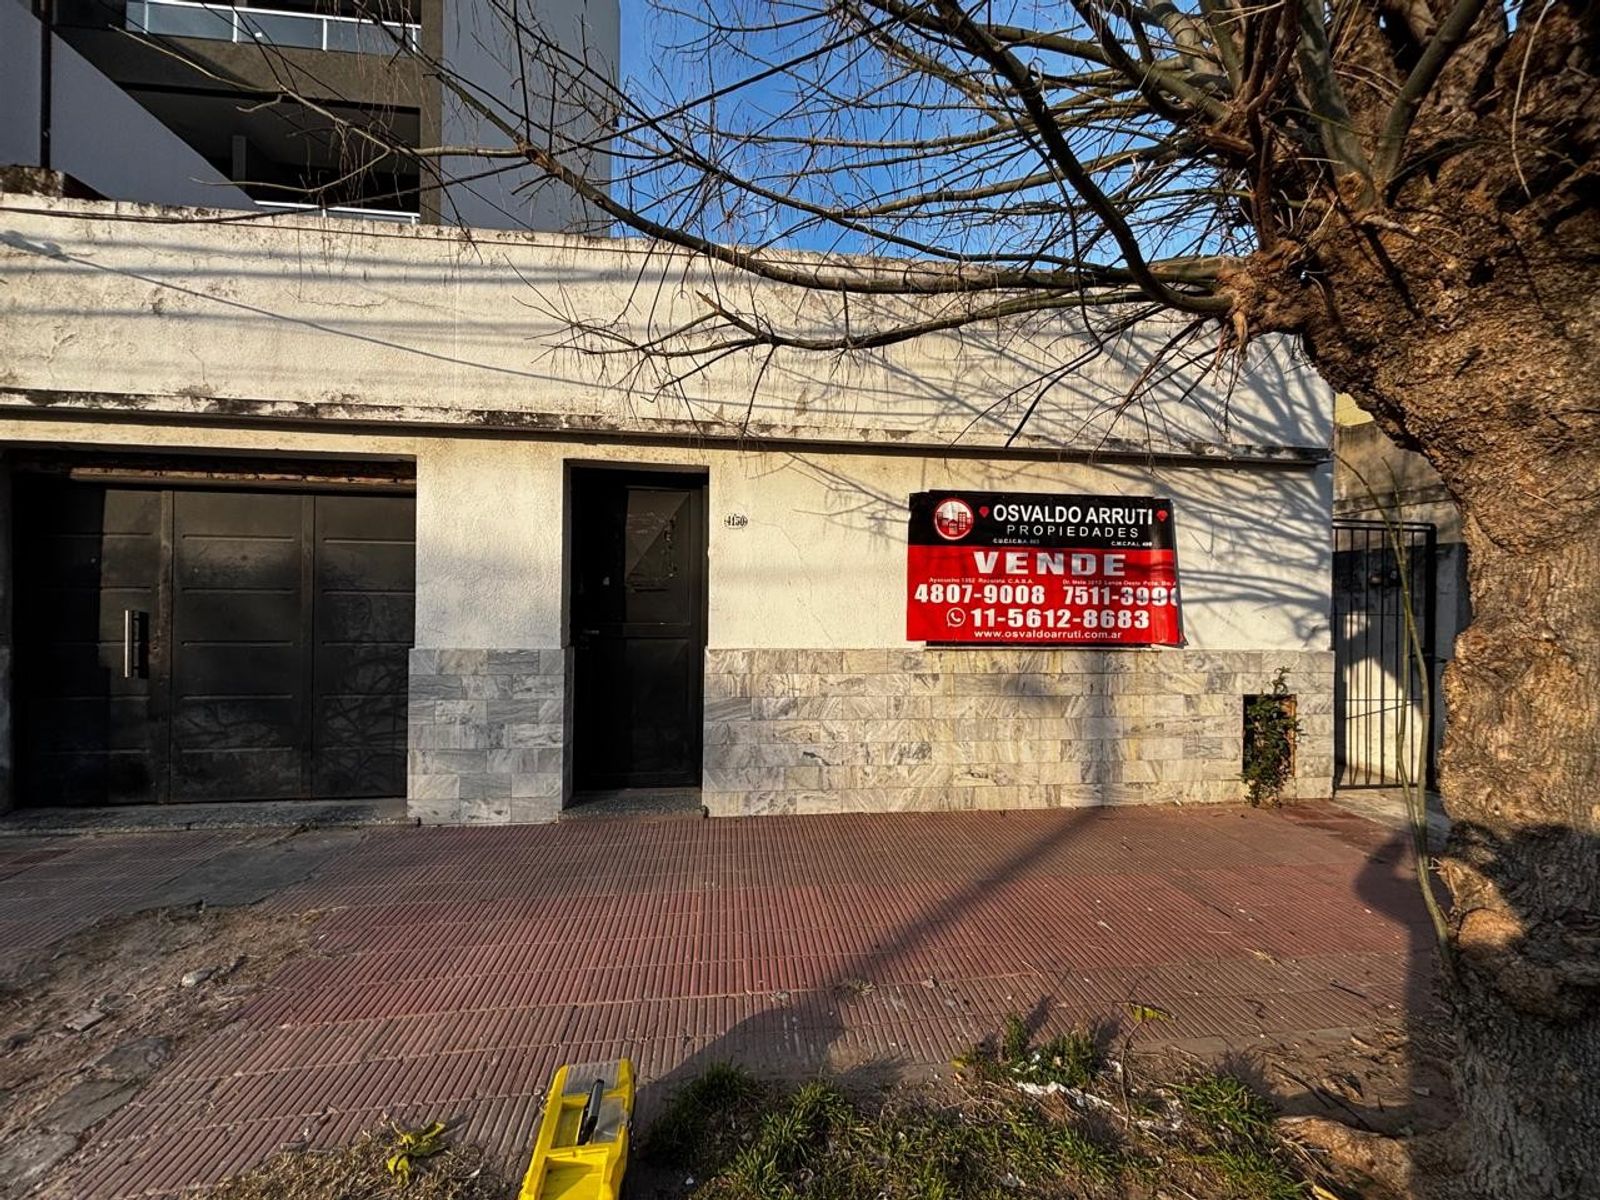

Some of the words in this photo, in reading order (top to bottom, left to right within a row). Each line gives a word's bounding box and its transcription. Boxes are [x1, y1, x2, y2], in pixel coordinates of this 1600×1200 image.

[993, 503, 1082, 525] OSVALDO
[1085, 507, 1153, 526] ARRUTI
[1006, 524, 1139, 539] PROPIEDADES
[973, 551, 1127, 577] VENDE
[914, 584, 1045, 605] 4807-9008
[970, 608, 1150, 629] 11-5612-8683
[974, 630, 1122, 639] www.osvaldoarruti.com.ar
